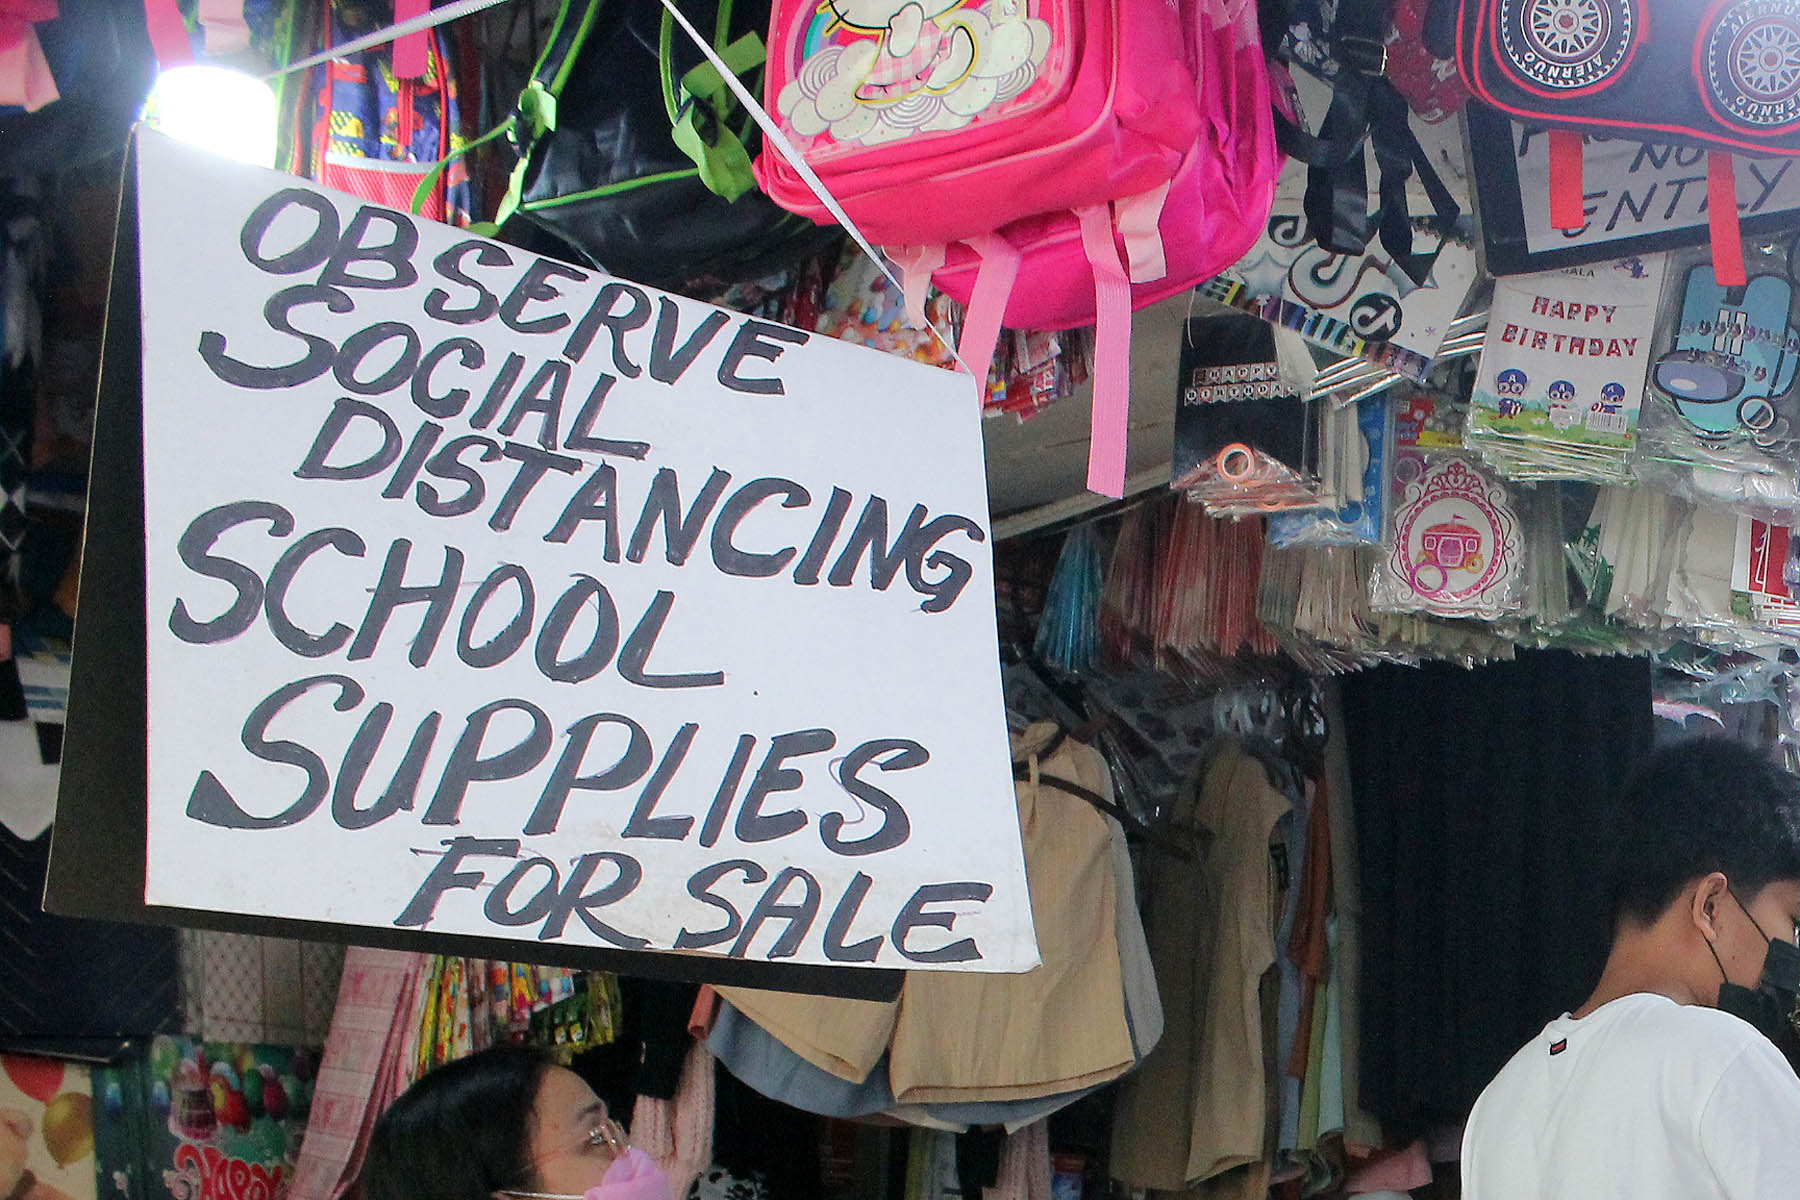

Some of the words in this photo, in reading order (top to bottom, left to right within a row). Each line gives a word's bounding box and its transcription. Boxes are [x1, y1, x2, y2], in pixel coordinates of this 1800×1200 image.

[200, 283, 651, 463] SOCIAL
[239, 187, 812, 398] OBSERVE
[1501, 323, 1638, 358] BIRTHDAY
[1531, 296, 1617, 324] HAPPY
[168, 500, 726, 690] SCHOOL
[293, 396, 986, 614] DISTANCING
[184, 674, 931, 858] SUPPLIES
[397, 836, 652, 952] FOR
[675, 856, 994, 966] SALE
